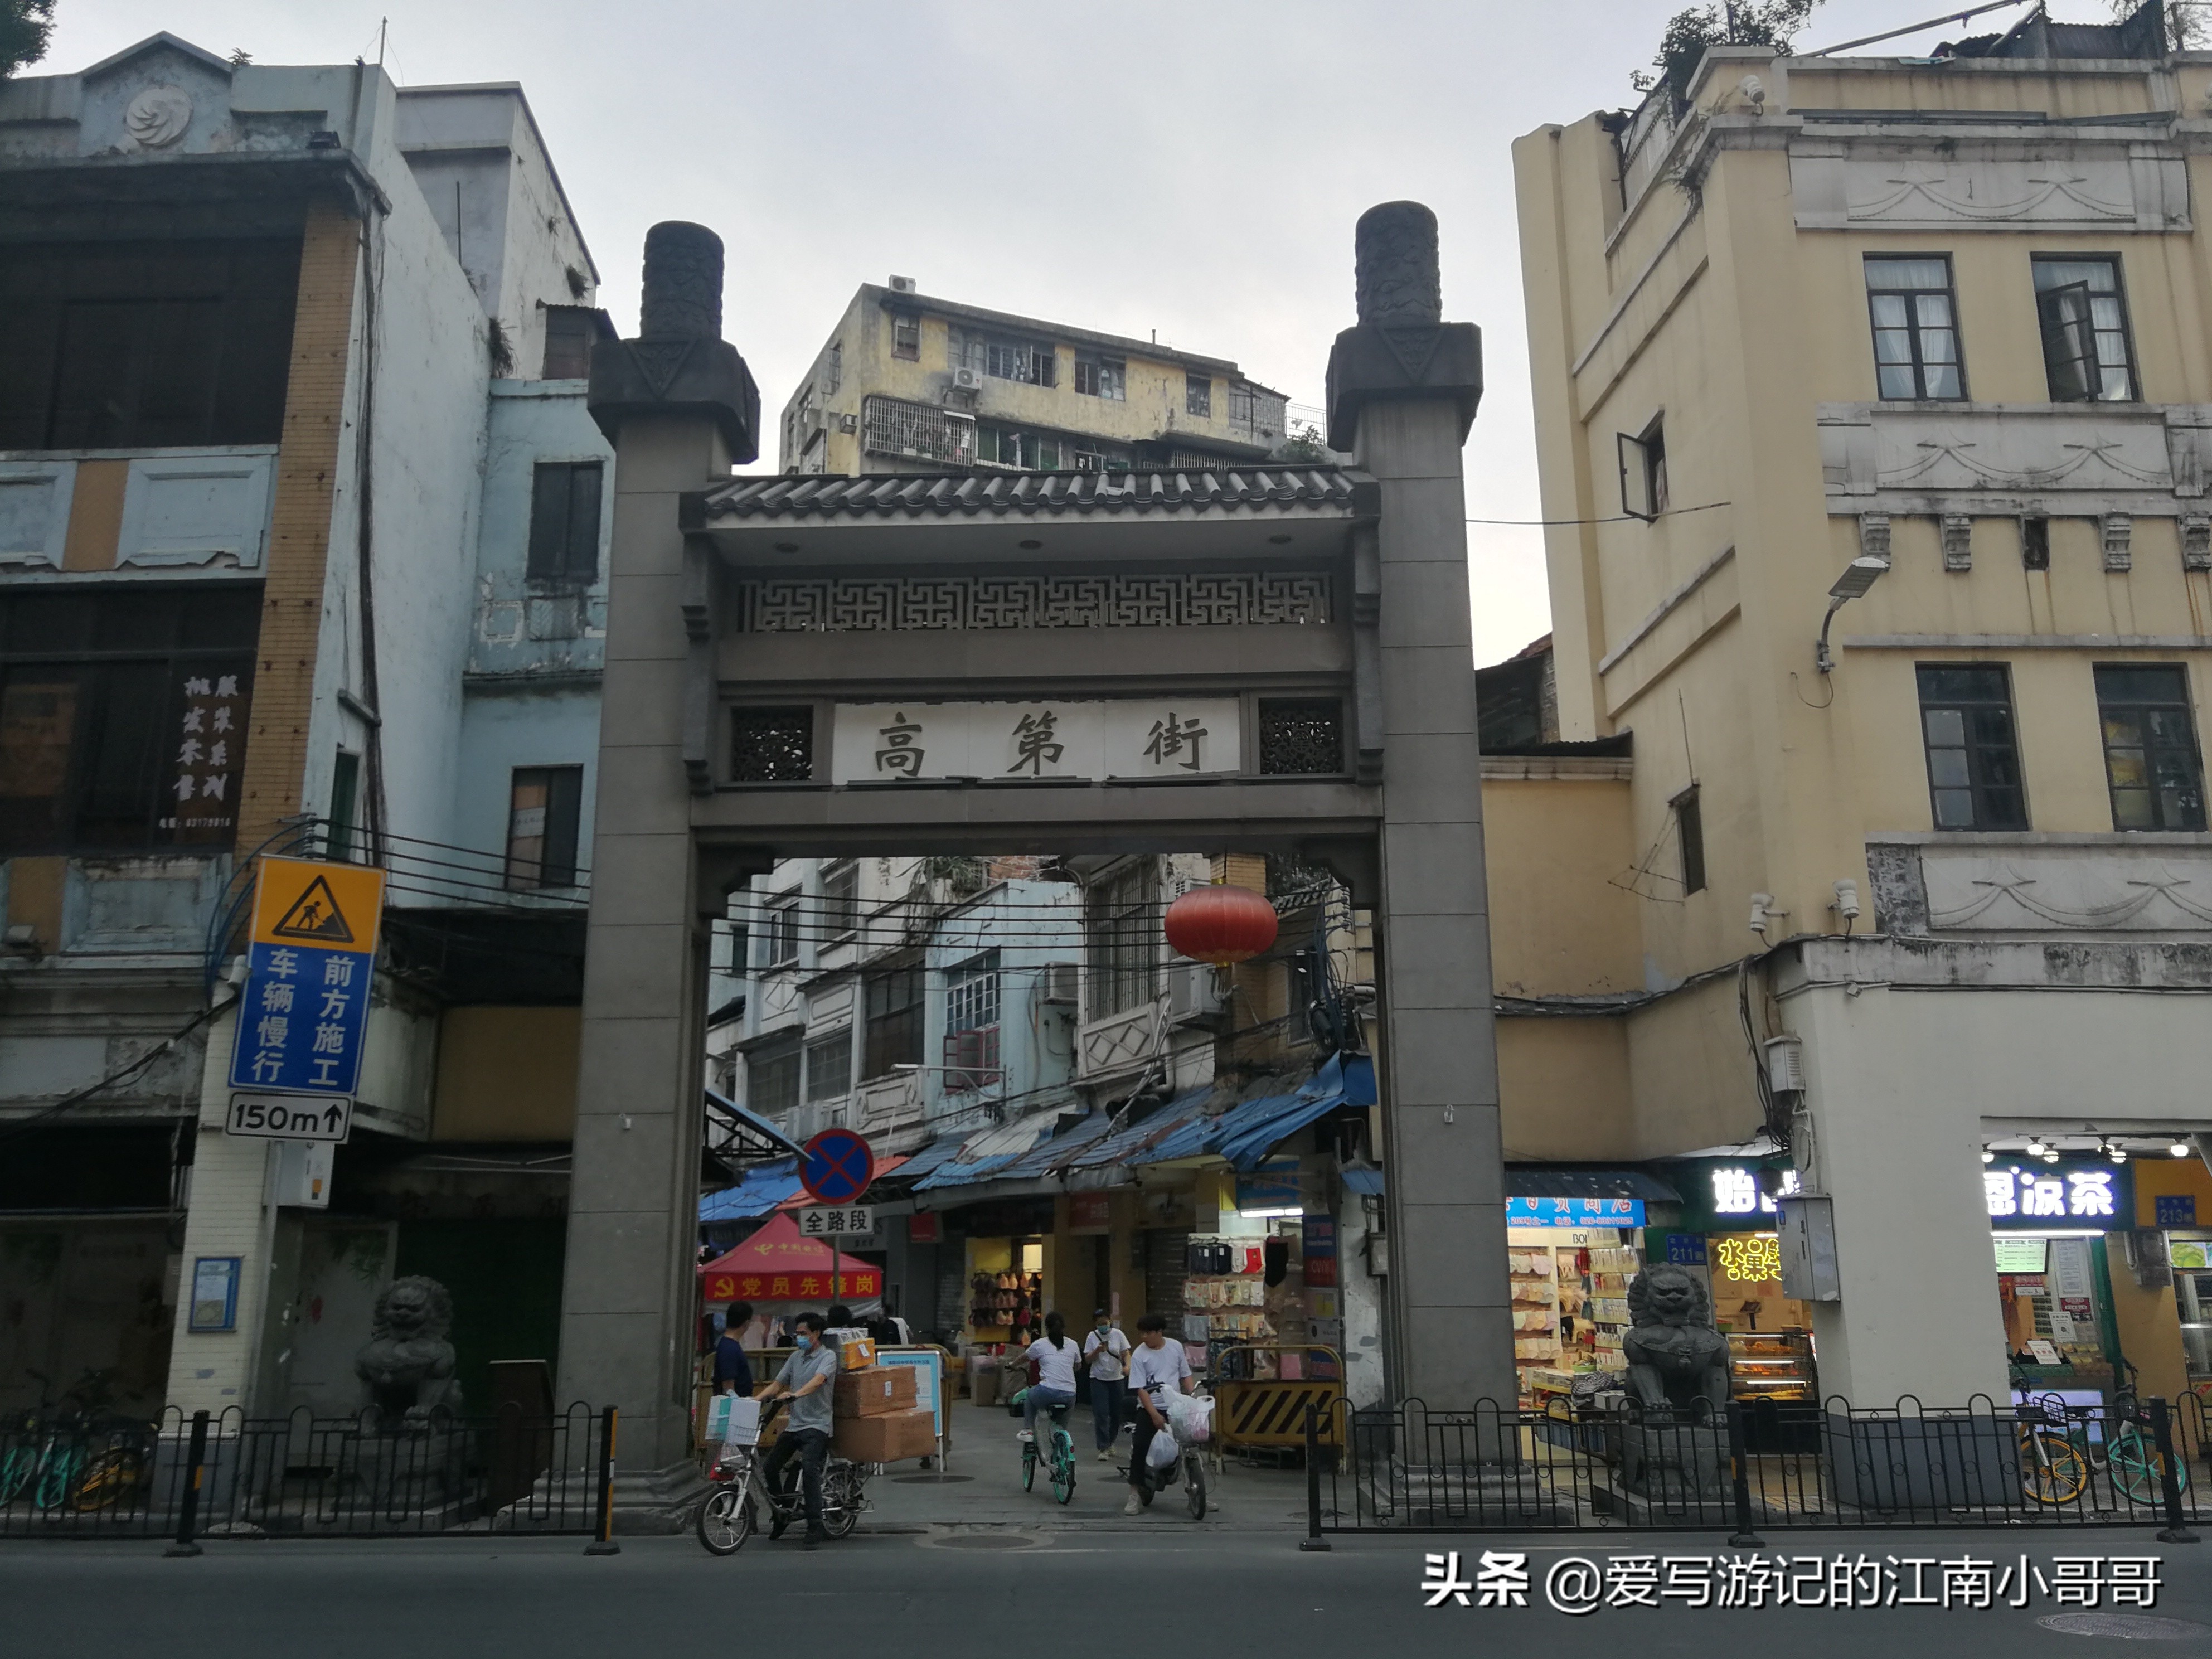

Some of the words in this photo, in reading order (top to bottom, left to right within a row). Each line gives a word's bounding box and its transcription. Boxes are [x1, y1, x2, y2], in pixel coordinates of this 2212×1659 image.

[874, 711, 1209, 779] 高第街
[251, 948, 299, 1083] 车辆慢行
[308, 955, 356, 1087] 前方施工
[235, 1104, 319, 1133] 150m
[804, 1209, 868, 1234] 全路段
[1671, 1247, 1693, 1262] 211
[741, 1274, 874, 1297] 党员先锋岗
